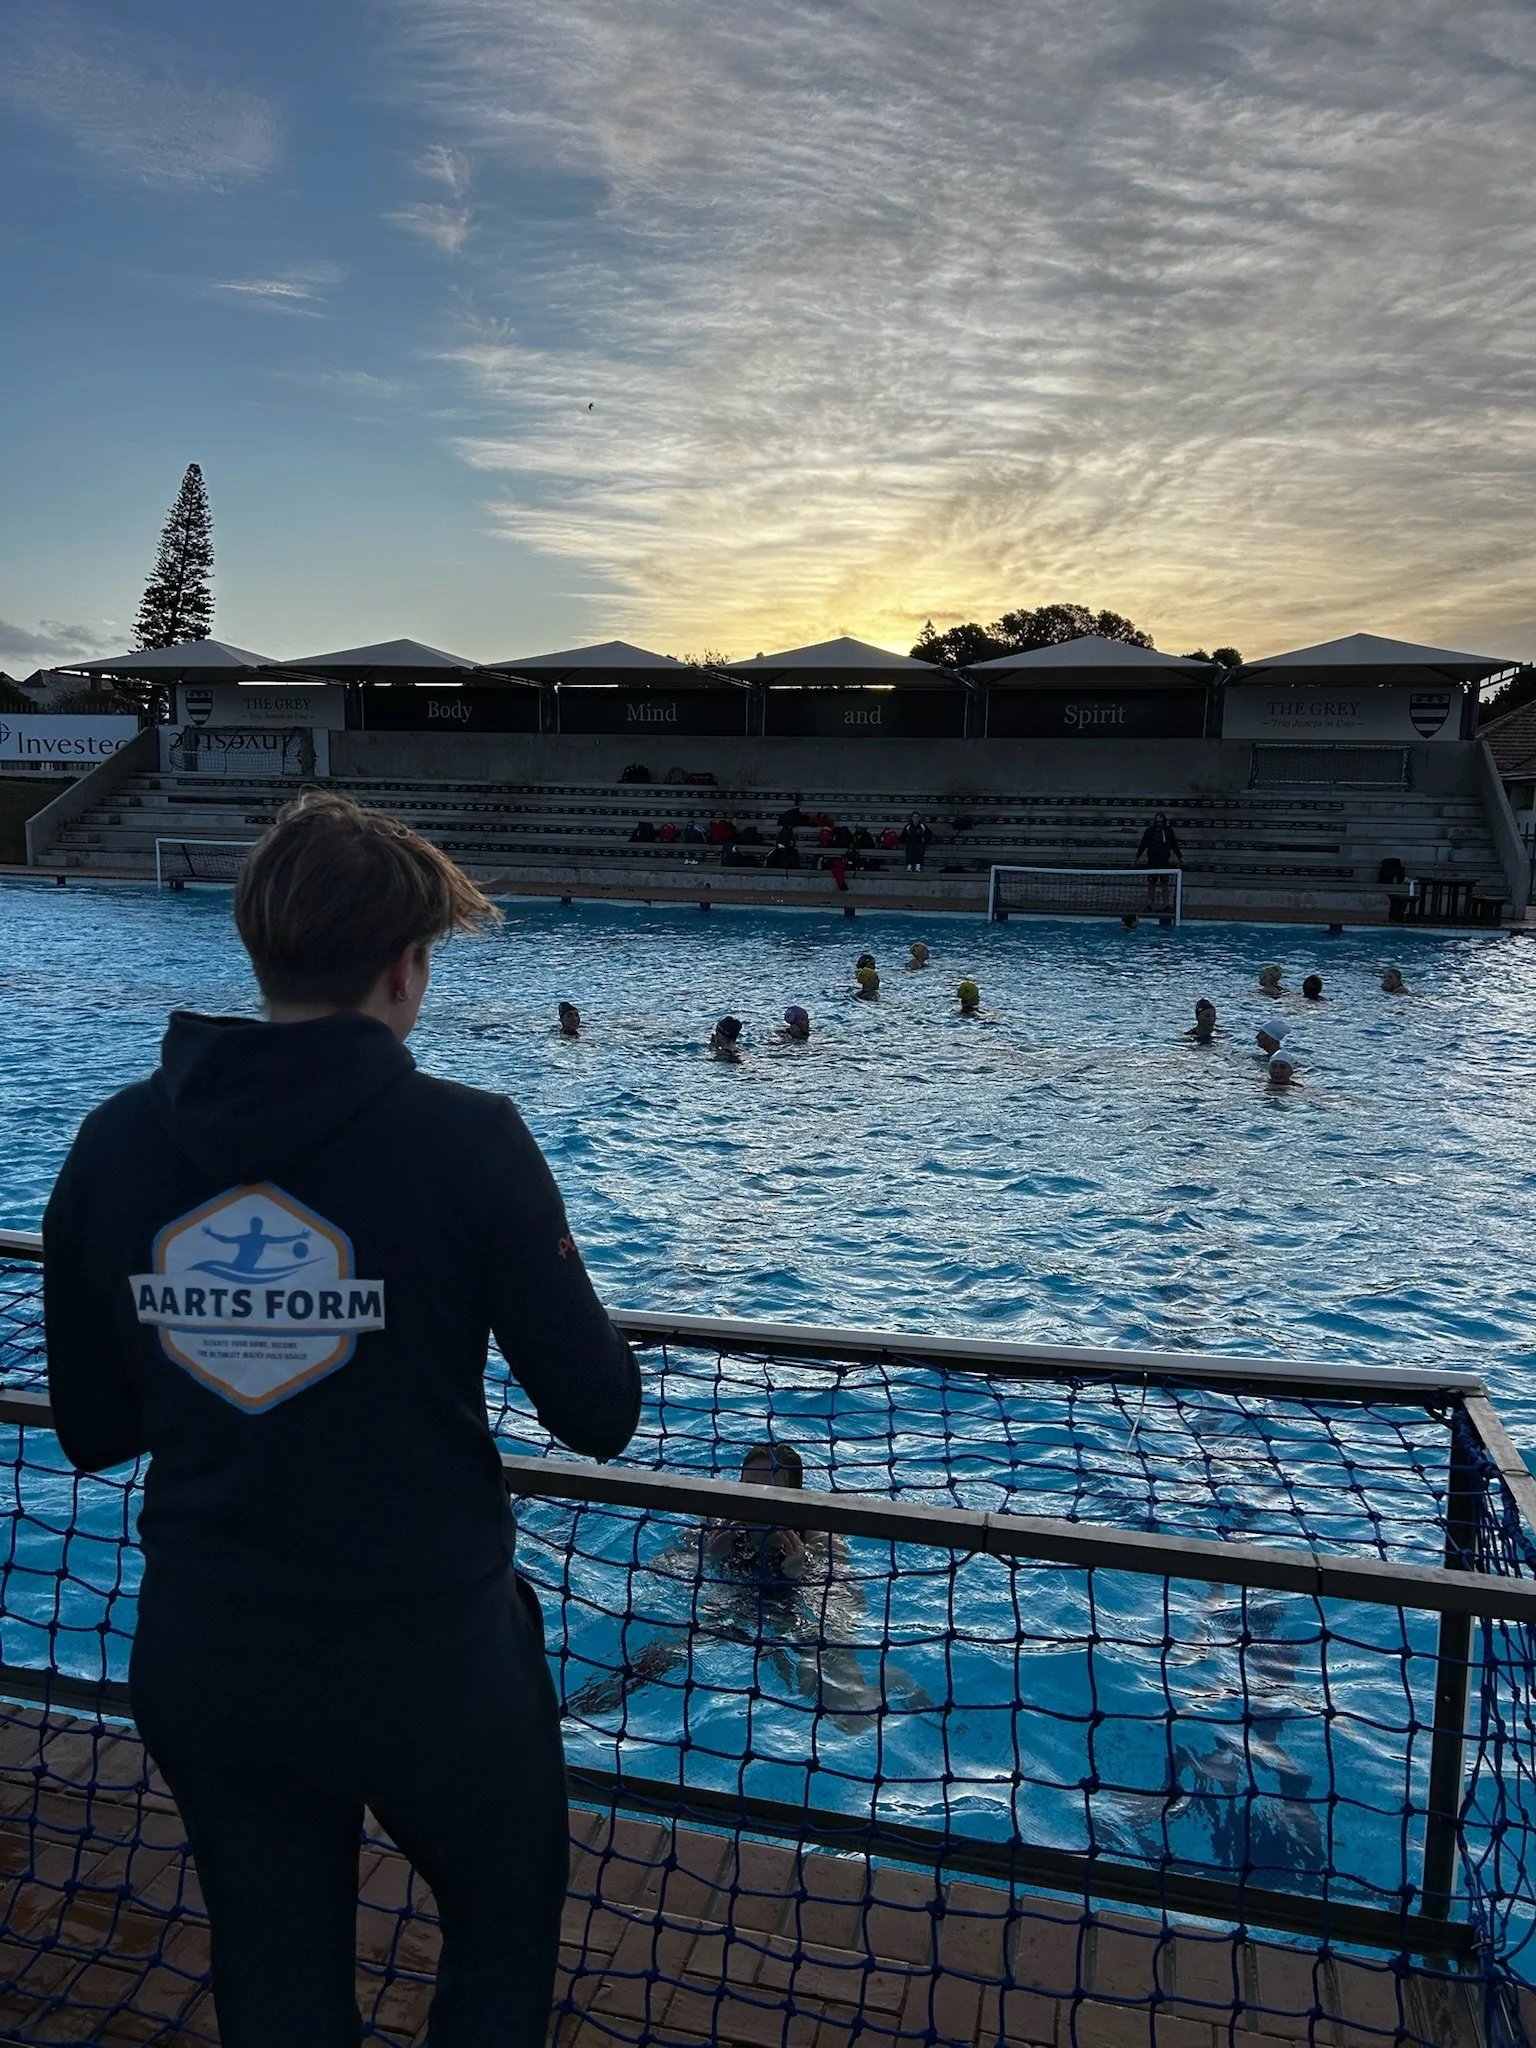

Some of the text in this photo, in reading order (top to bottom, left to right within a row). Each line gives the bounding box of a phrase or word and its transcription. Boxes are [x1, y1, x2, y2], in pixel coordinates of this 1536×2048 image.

[243, 698, 311, 710] THE GREY
[427, 700, 473, 723] Body
[626, 703, 677, 723] Mind
[1267, 702, 1360, 715] THE GREY
[843, 705, 882, 725] and
[1063, 704, 1127, 729] Spirit
[138, 1284, 382, 1320] AARTS FORM
